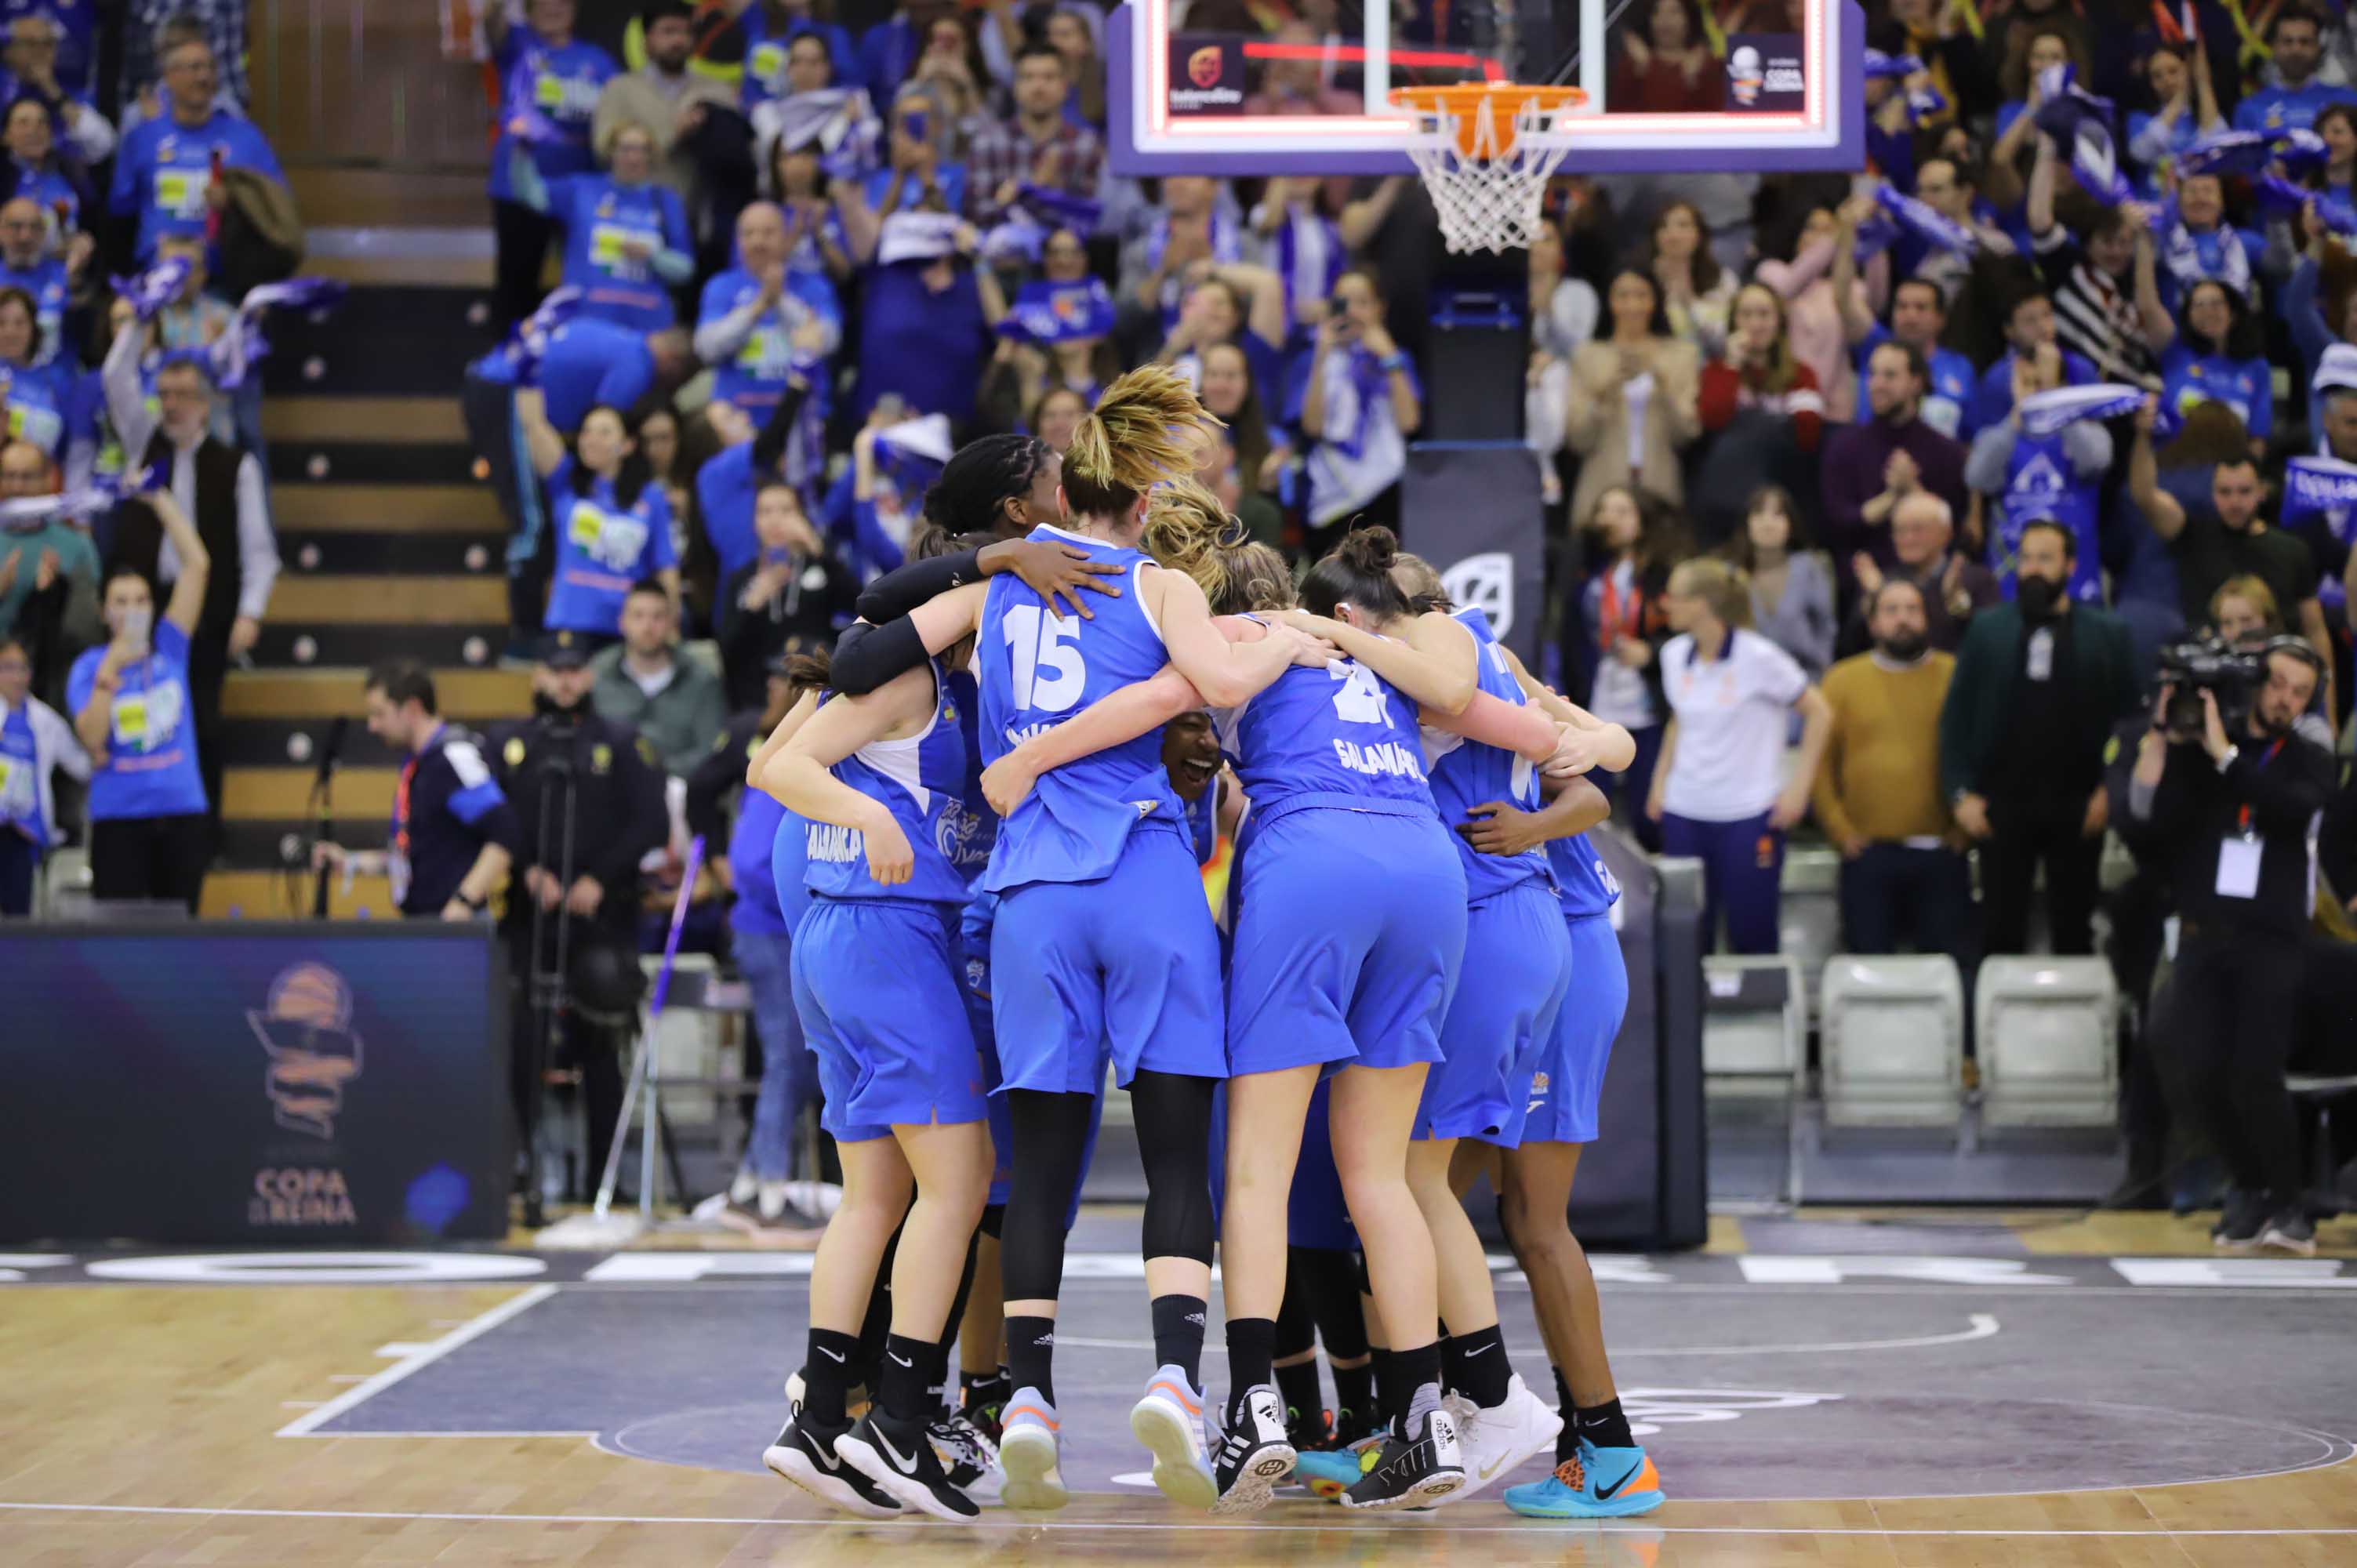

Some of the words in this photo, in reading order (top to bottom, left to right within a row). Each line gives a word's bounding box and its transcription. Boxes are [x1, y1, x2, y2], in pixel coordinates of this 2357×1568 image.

[1003, 604, 1086, 712] 15
[1333, 738, 1428, 782] SALAMAN
[254, 1167, 348, 1199] COPA
